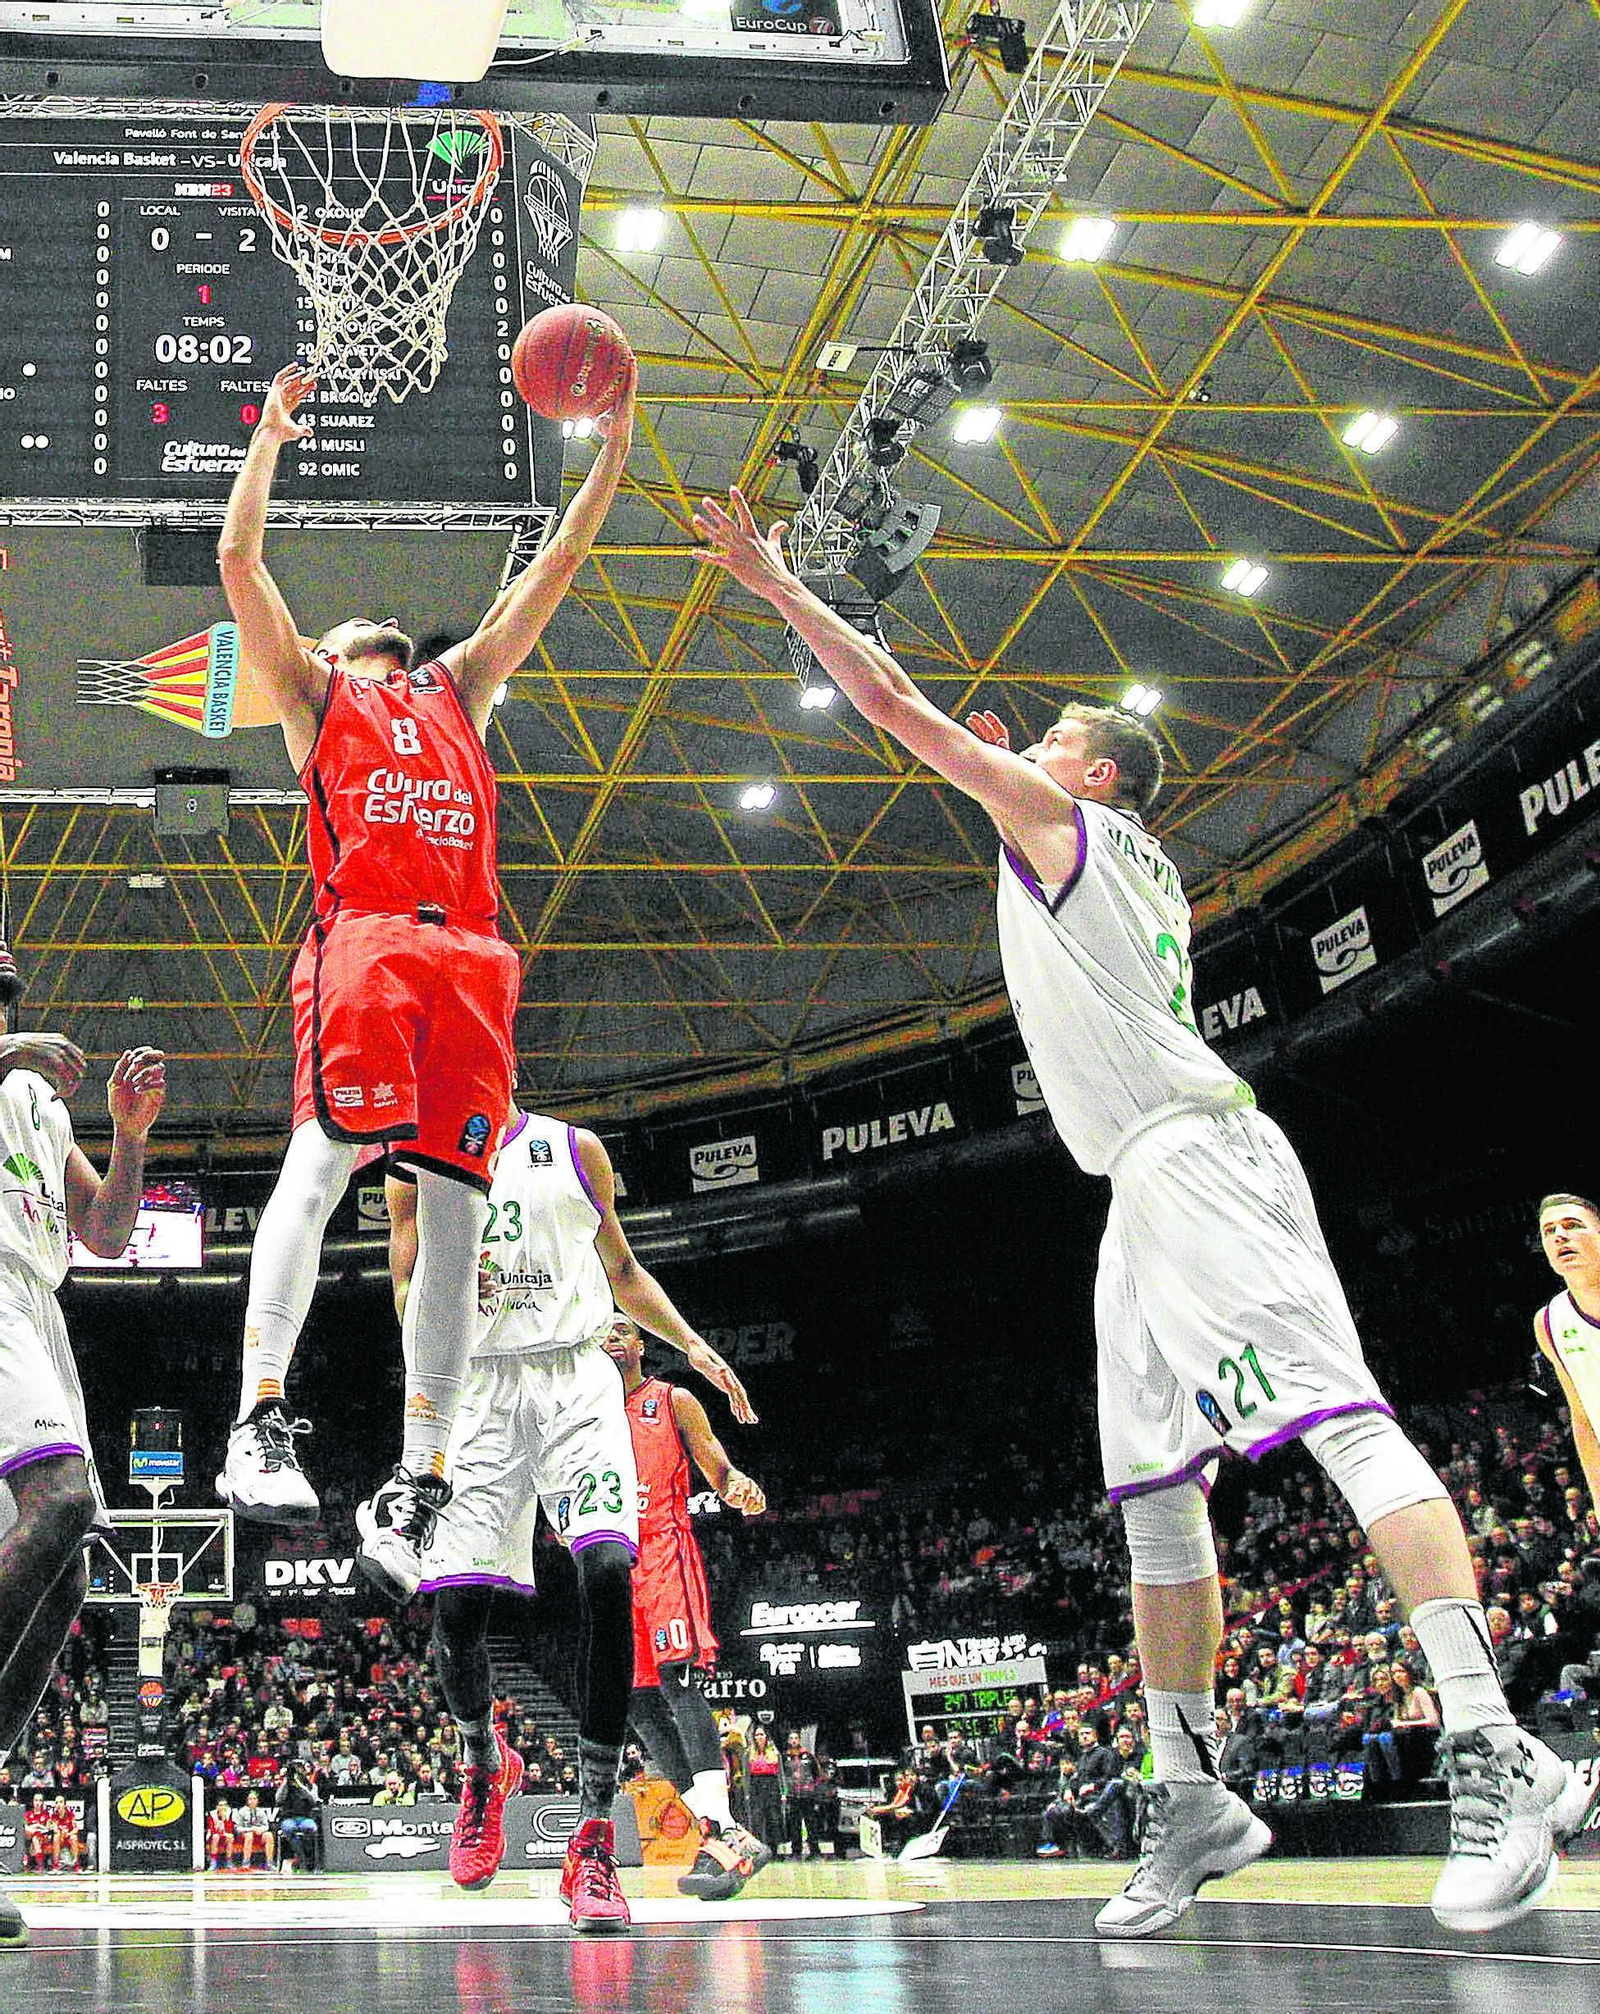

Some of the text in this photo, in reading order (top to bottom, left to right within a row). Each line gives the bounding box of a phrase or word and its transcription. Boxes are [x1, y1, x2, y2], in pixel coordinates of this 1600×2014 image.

[736, 17, 808, 33] EuroCup
[125, 128, 167, 139] Pavelló
[171, 128, 197, 139] Font
[201, 129, 217, 139] de
[53, 151, 120, 166] Valencia
[123, 152, 177, 168] Basket
[97, 202, 110, 217] 0
[139, 205, 181, 216] LOCAL
[296, 204, 309, 220] 2
[490, 207, 503, 223] 0
[97, 224, 110, 240] 0
[150, 227, 170, 251] 0
[238, 229, 257, 252] 2
[491, 230, 504, 246] 0
[96, 246, 110, 262] 0
[492, 253, 505, 269] 0
[96, 269, 109, 285] 0
[176, 263, 231, 275] PERIODE
[494, 275, 506, 291] 0
[96, 292, 109, 308] 0
[198, 284, 211, 304] 1
[296, 296, 314, 310] 15
[495, 298, 508, 313] 0
[95, 315, 109, 331] 0
[182, 316, 226, 328] TEMPS
[296, 319, 315, 332] 16
[496, 320, 509, 336] 2
[95, 338, 109, 355] 0
[155, 334, 253, 364] 08:02
[296, 342, 315, 356] 20
[498, 343, 511, 360] 0
[95, 361, 108, 379] 0
[499, 367, 512, 384] 0
[94, 385, 108, 402] 0
[136, 380, 272, 393] FALTES FALTES
[501, 390, 513, 408] 0
[94, 409, 108, 426] 0
[151, 402, 259, 425] 3 0
[320, 414, 375, 428] SUAREZ
[502, 414, 514, 432] 0
[94, 433, 108, 451] 0
[163, 440, 231, 457] Cultura
[297, 438, 515, 455] 44 MUSLI 0
[93, 457, 108, 475] 0
[298, 462, 516, 480] 92 OMIC 0
[209, 631, 235, 733] VALENCIA BASKET
[390, 717, 423, 756] 8
[452, 789, 473, 806] del
[1428, 833, 1477, 879] PULEVA
[1316, 918, 1366, 958] PULEVA
[823, 1102, 956, 1160] PULEVA
[694, 1143, 753, 1166] PULEVA
[481, 1200, 523, 1244] 23
[500, 1270, 553, 1286] Unicaja
[1218, 1342, 1277, 1420] 21
[578, 1470, 623, 1516] 23
[264, 1558, 355, 1587] DKV
[668, 1617, 689, 1650] 0
[127, 1792, 175, 1821] AP
